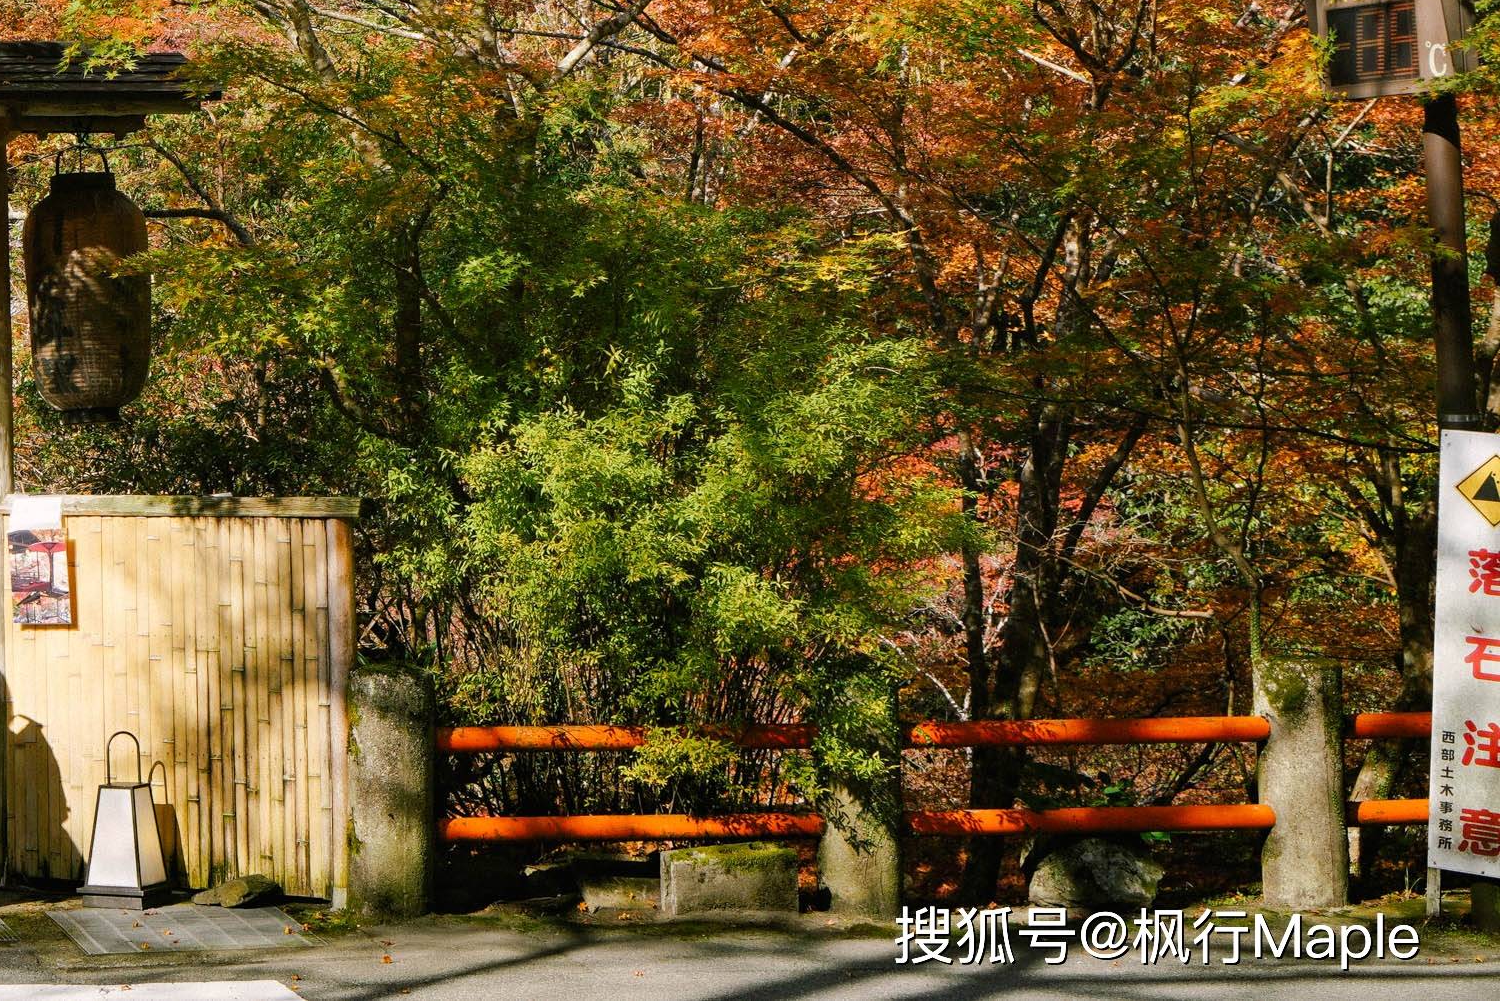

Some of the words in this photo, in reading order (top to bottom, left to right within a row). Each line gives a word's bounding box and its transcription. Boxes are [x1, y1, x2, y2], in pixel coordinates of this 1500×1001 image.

[1437, 730, 1456, 851] 西部土木事務所
